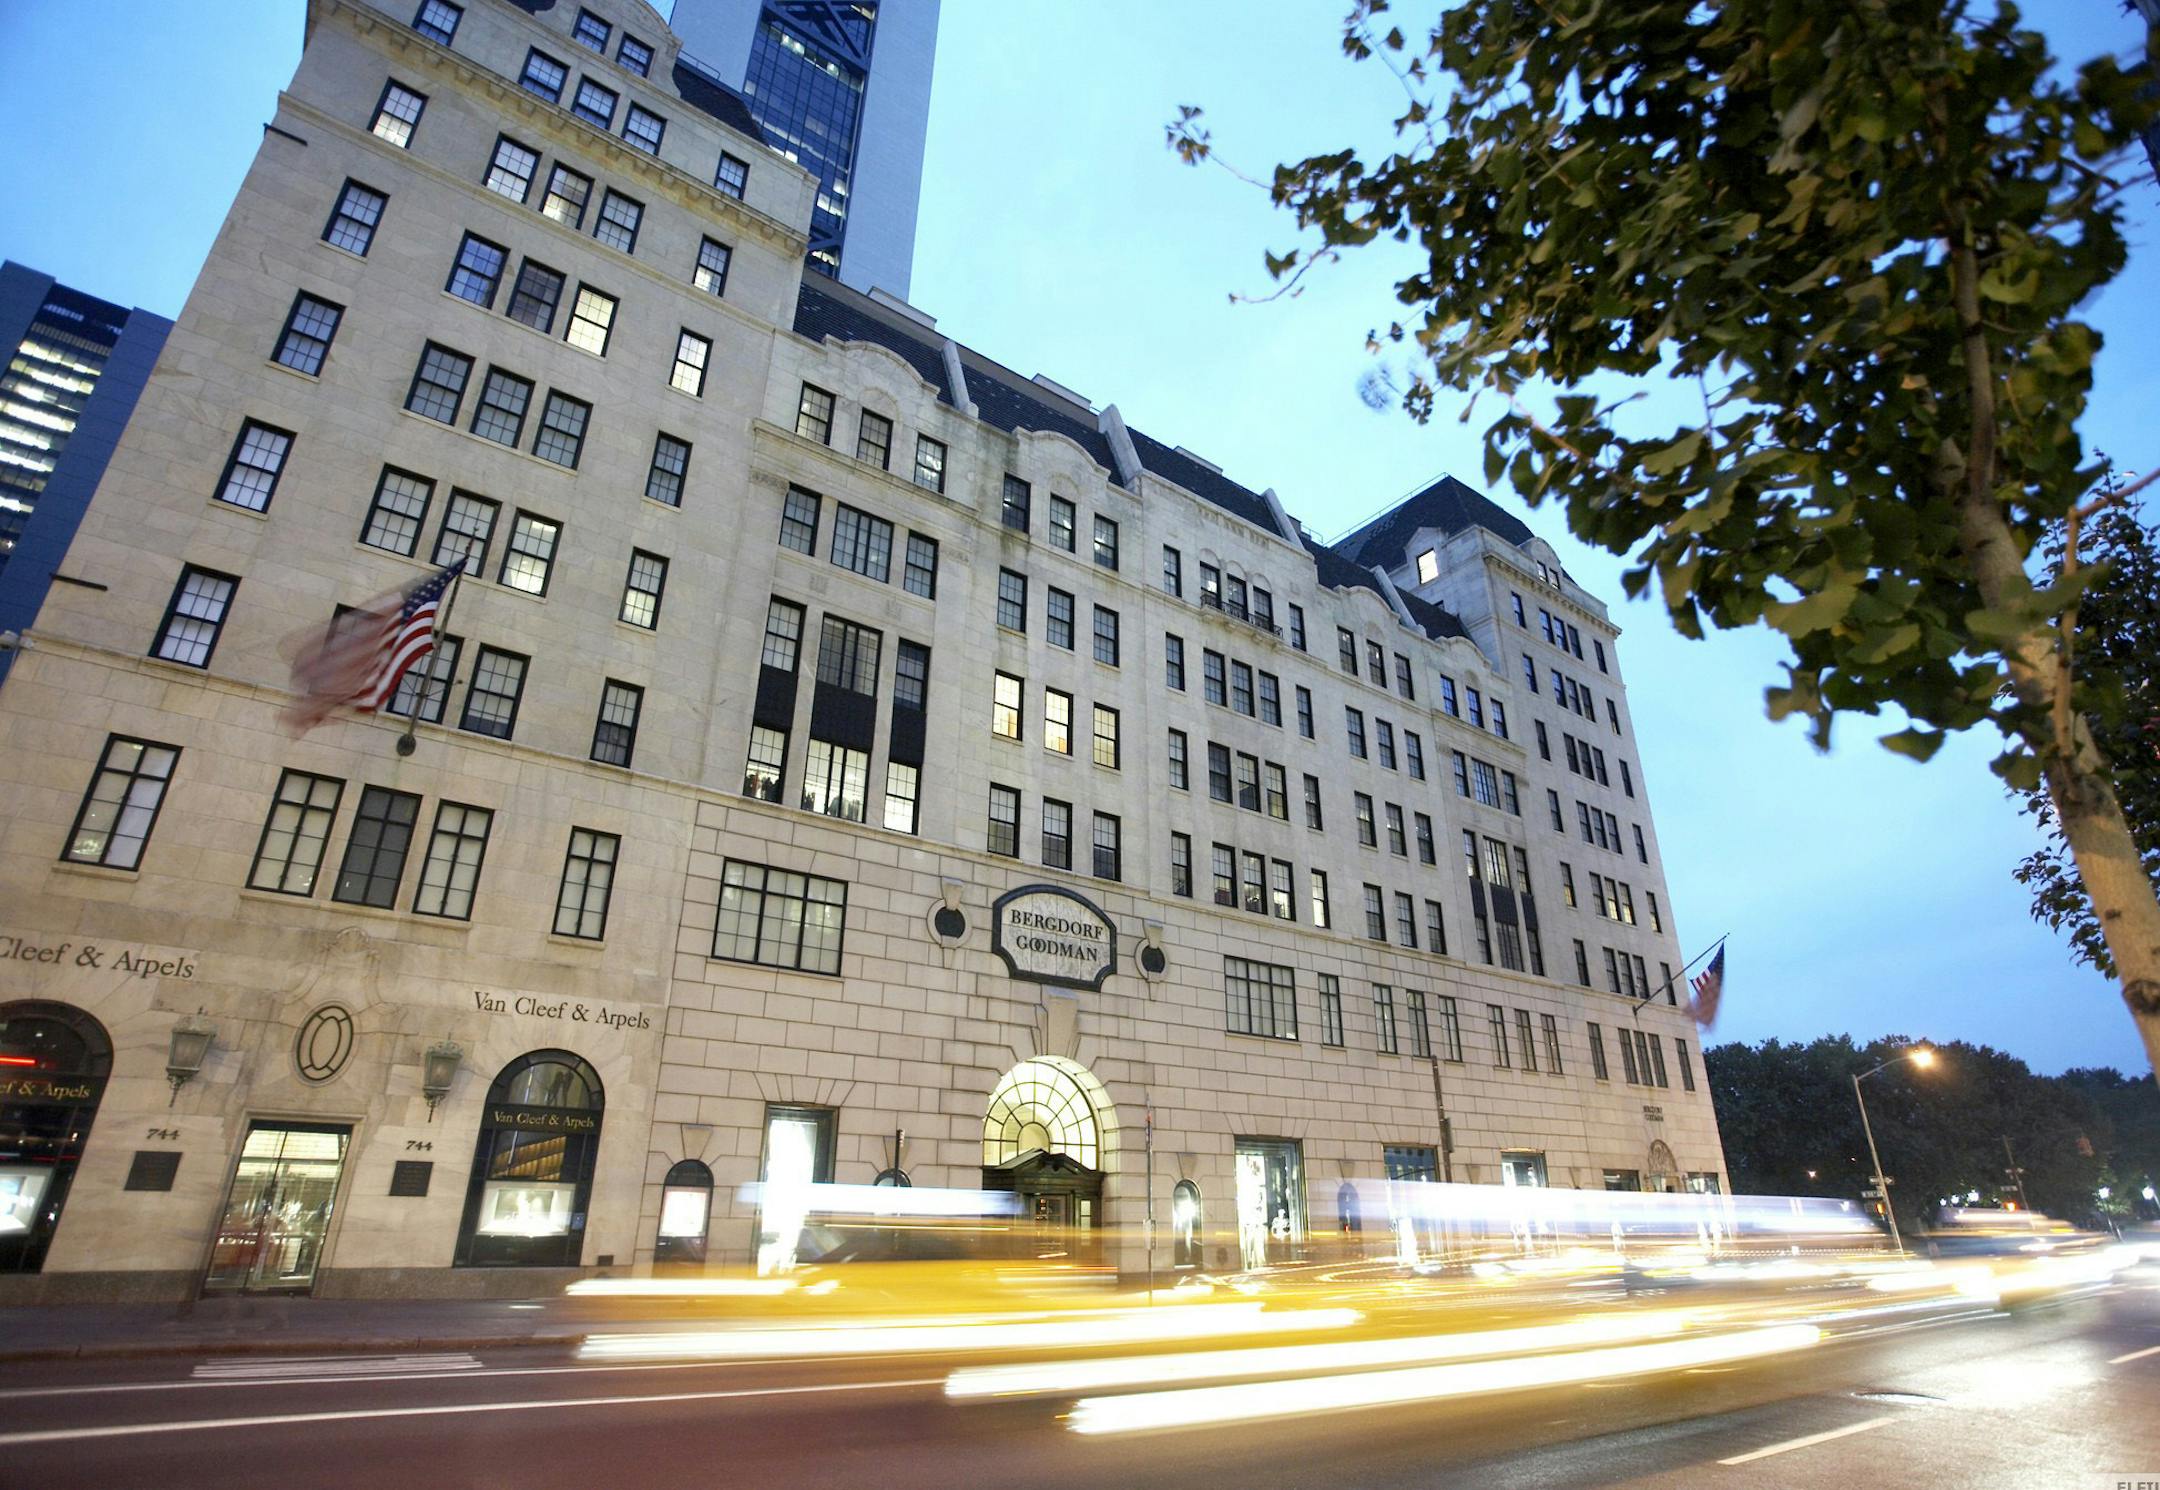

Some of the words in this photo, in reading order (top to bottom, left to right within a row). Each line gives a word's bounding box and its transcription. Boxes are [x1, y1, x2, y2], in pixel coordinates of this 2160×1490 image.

[1010, 909, 1103, 940] BERGDORF
[1016, 935, 1098, 962] GOODMAN
[75, 945, 104, 969] &
[110, 950, 195, 979] Arpels
[474, 991, 506, 1013] Van
[515, 996, 568, 1019] Cleef
[572, 1003, 591, 1022] &
[596, 1007, 650, 1030] Arpels
[18, 1081, 36, 1096] &
[42, 1082, 91, 1101] Arpels
[494, 1110, 513, 1124] Van
[517, 1112, 547, 1125] Cleef
[548, 1114, 560, 1126] &
[563, 1115, 594, 1129] Arpels
[146, 1128, 180, 1140] 744
[406, 1140, 433, 1151] 744
